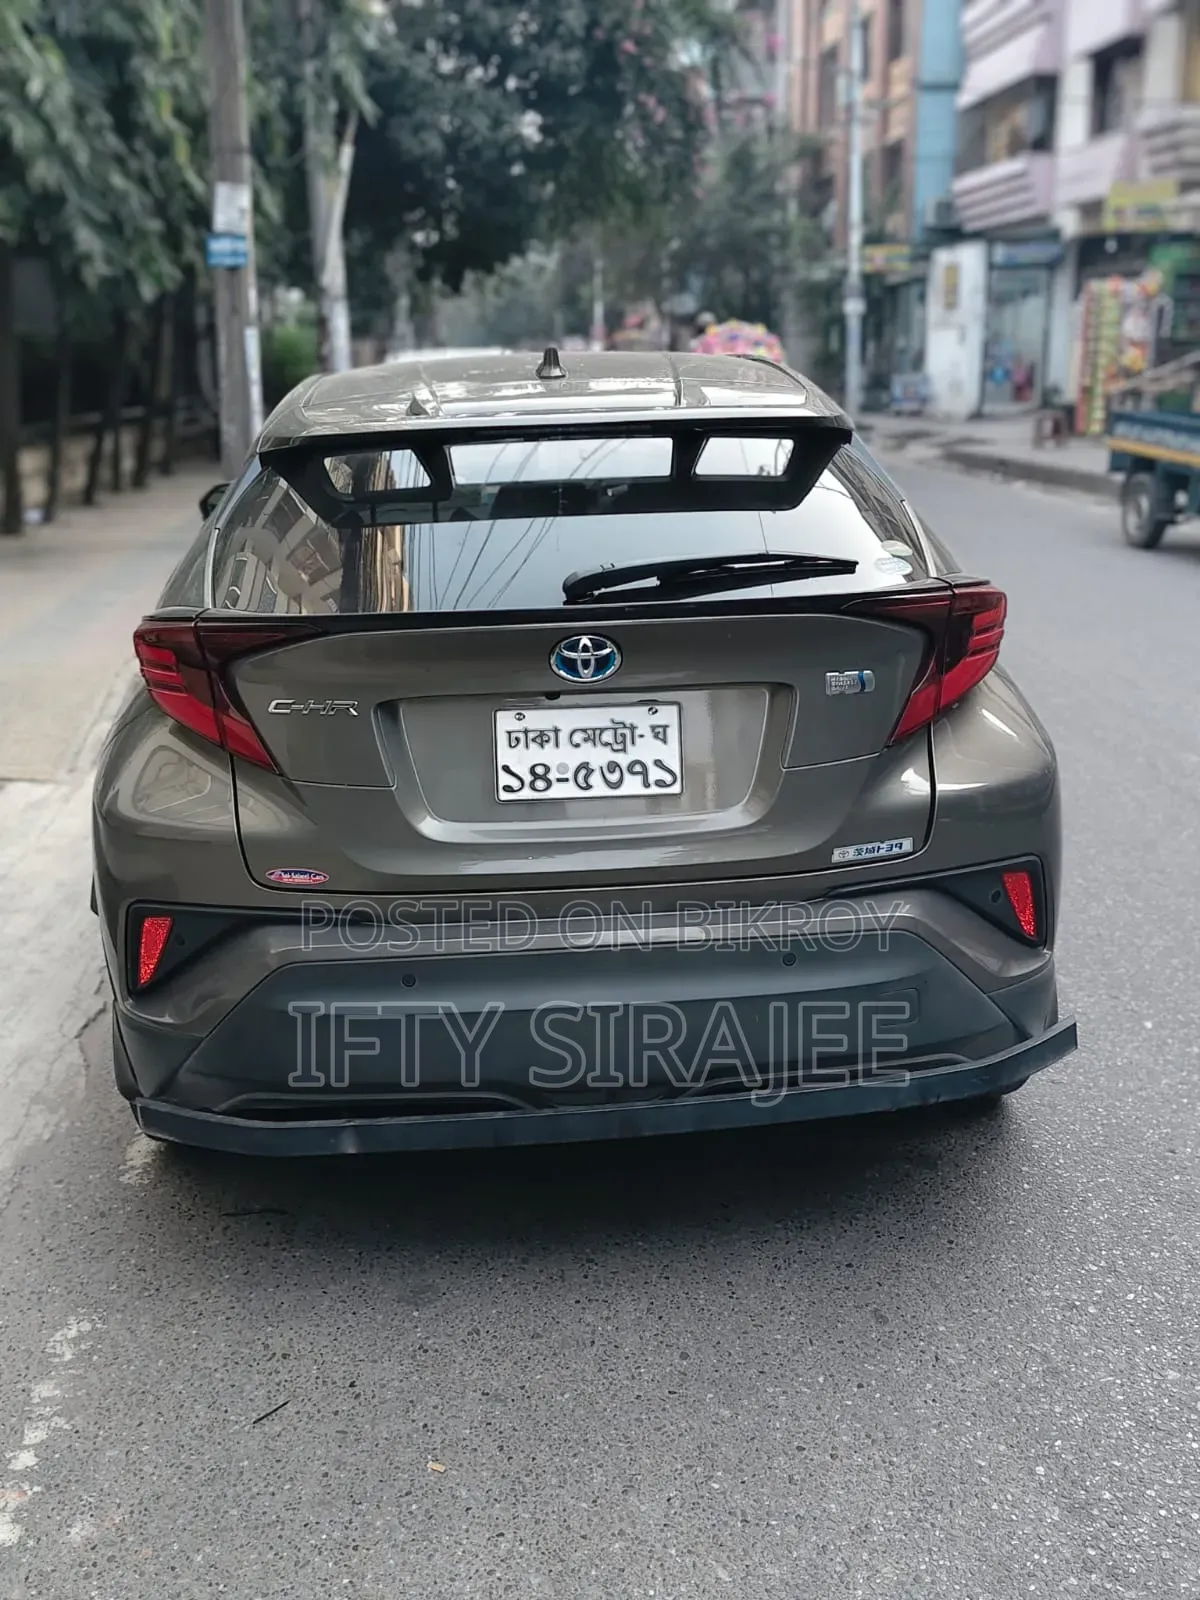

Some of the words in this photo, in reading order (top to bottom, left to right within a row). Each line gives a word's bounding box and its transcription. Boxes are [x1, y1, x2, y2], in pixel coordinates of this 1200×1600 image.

[267, 699, 358, 716] C-HR
[505, 726, 560, 750] ঢাকা
[501, 759, 677, 793] ১৪-৫৩৭১
